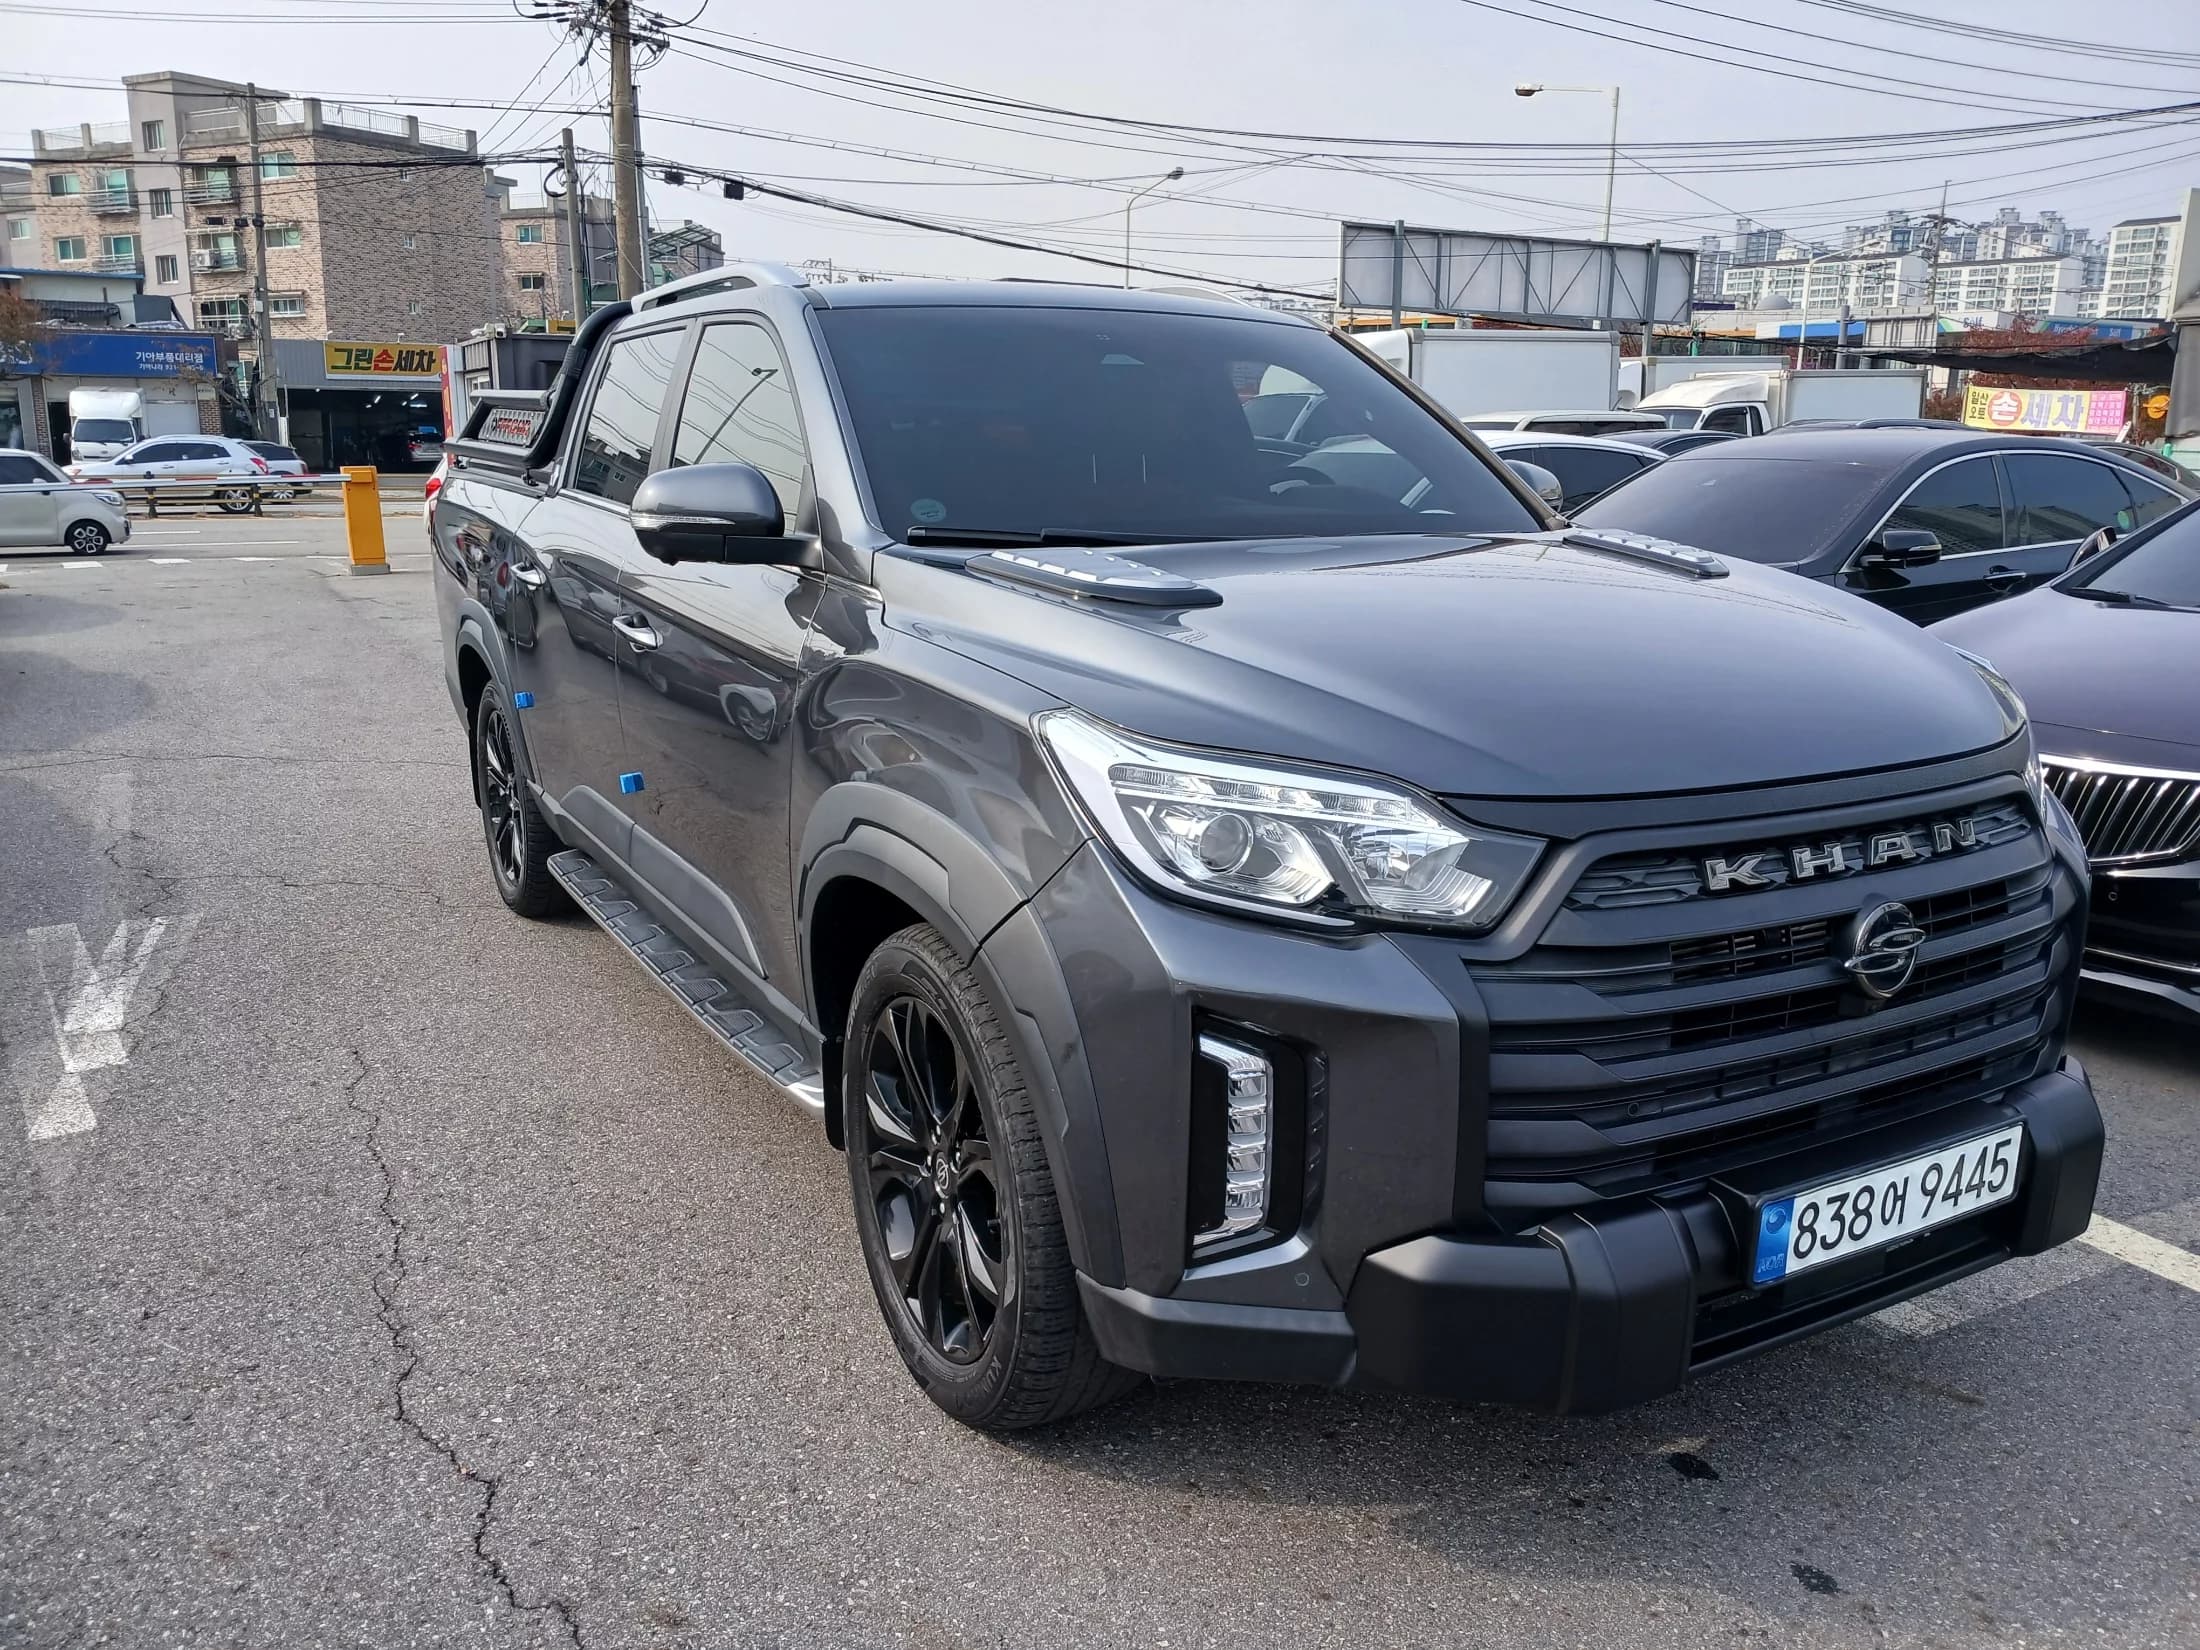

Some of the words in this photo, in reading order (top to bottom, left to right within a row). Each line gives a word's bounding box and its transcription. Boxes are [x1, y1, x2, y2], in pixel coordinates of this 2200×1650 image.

[135, 351, 204, 364] 기아부품대리점
[330, 347, 436, 372] 그린손세차
[1971, 391, 1989, 406] 일산
[1969, 407, 1986, 420] 오토
[1704, 818, 1977, 891] KHAN
[1793, 1176, 1909, 1259] 838어
[1920, 1138, 2012, 1219] 9445
